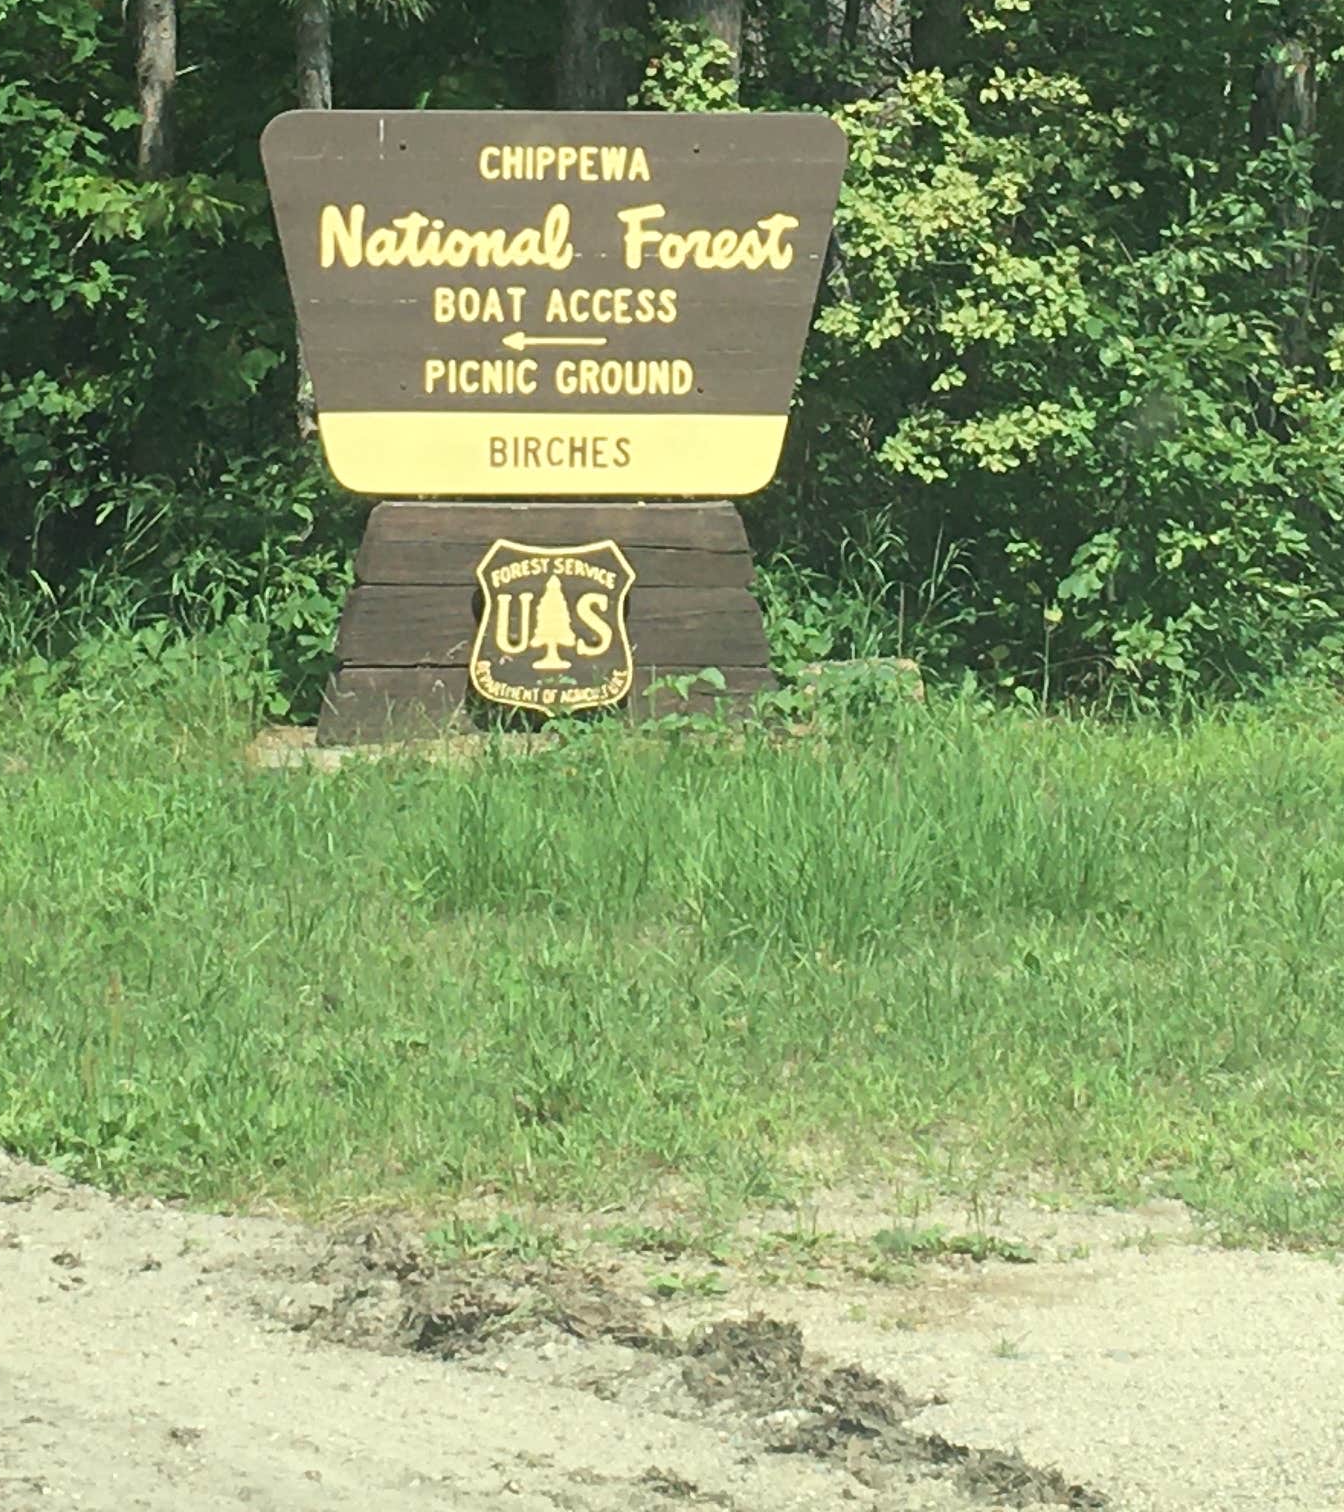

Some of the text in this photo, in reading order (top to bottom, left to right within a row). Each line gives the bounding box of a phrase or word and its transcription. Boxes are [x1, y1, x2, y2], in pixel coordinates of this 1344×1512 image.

[479, 145, 650, 182] CHIPPEWA
[320, 203, 799, 271] National Forest
[433, 287, 678, 324] BOAT ACCESS
[425, 360, 693, 395] PICNIC GROUND
[488, 436, 632, 469] BIRCHES
[491, 557, 617, 589] FOREST SERVICE
